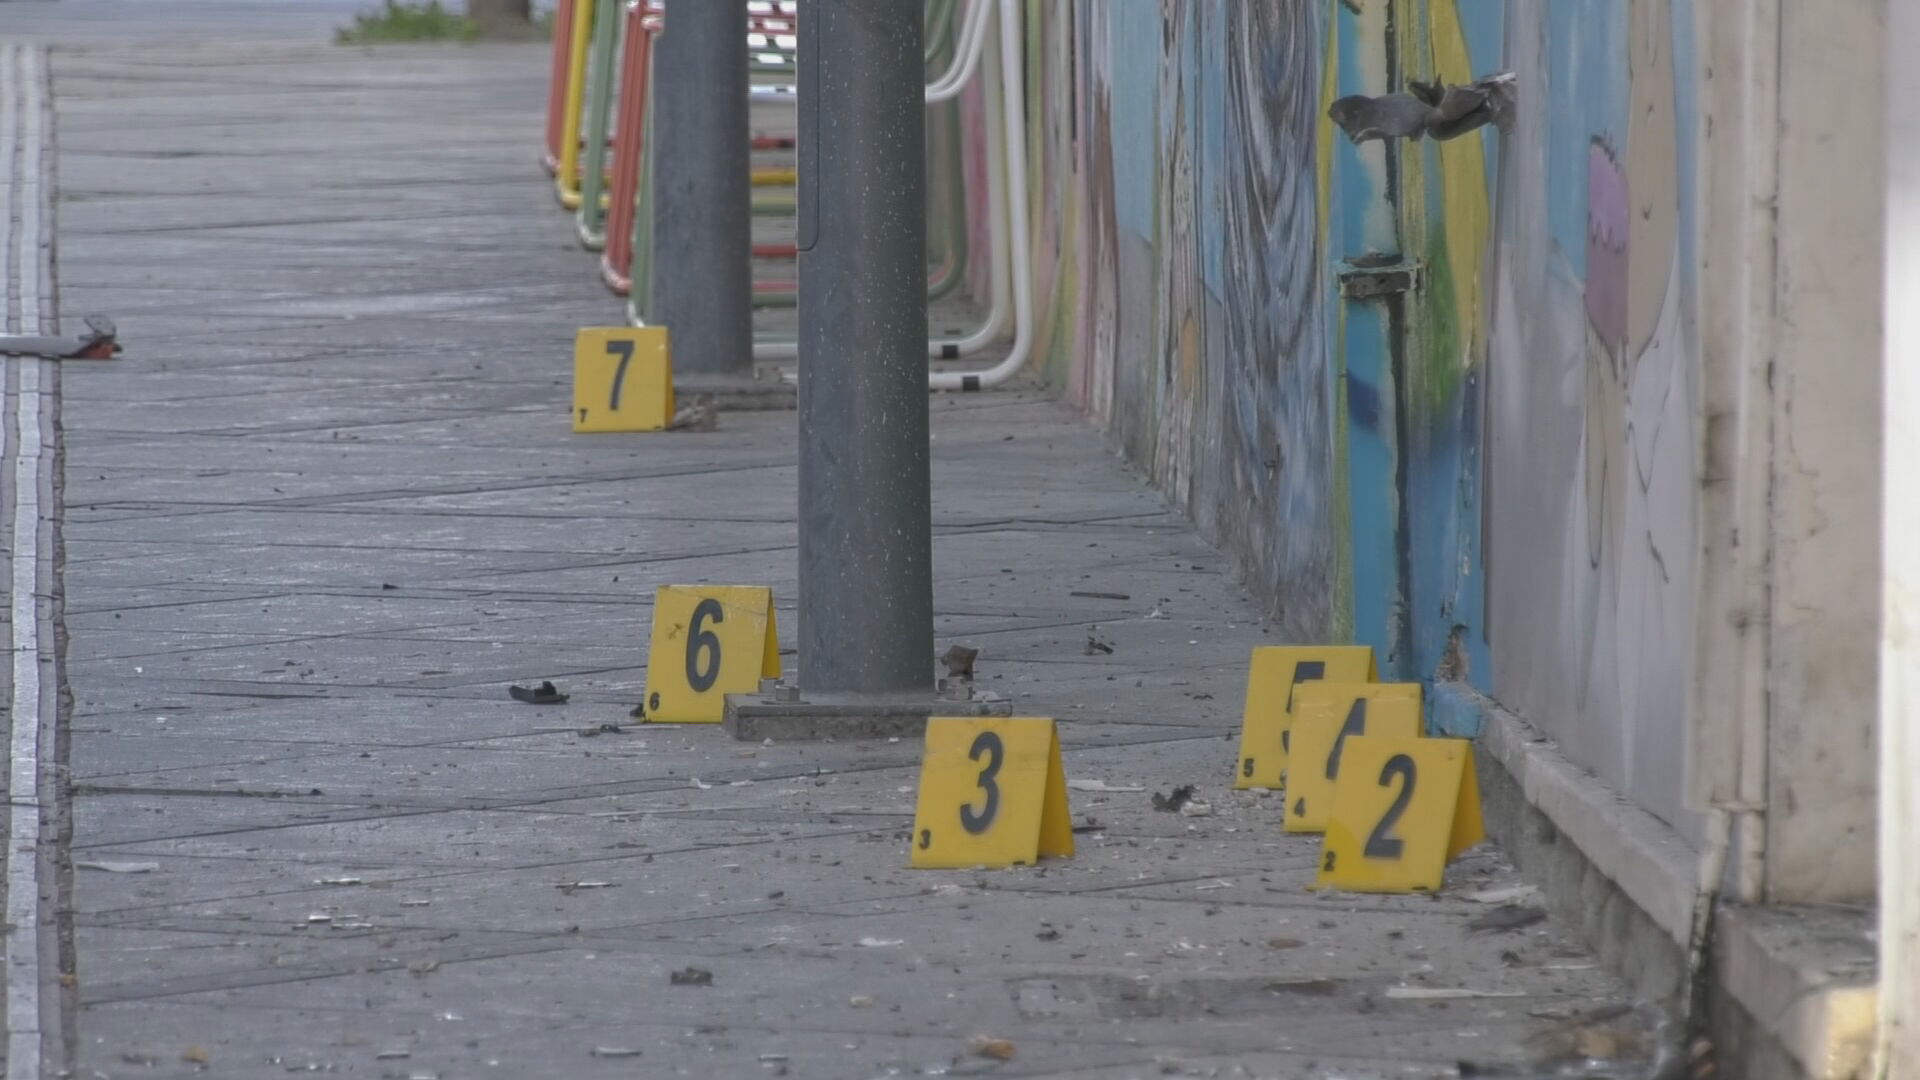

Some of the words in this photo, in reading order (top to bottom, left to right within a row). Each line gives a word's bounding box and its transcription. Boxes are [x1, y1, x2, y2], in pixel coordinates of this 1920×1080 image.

[606, 339, 635, 411] 7
[685, 598, 724, 693] 6
[649, 692, 660, 711] 6
[1243, 757, 1254, 778] 5
[960, 731, 1004, 836] 3
[1294, 797, 1306, 818] 4
[1362, 753, 1417, 860] 2
[919, 829, 932, 851] 3
[1322, 850, 1336, 873] 2
